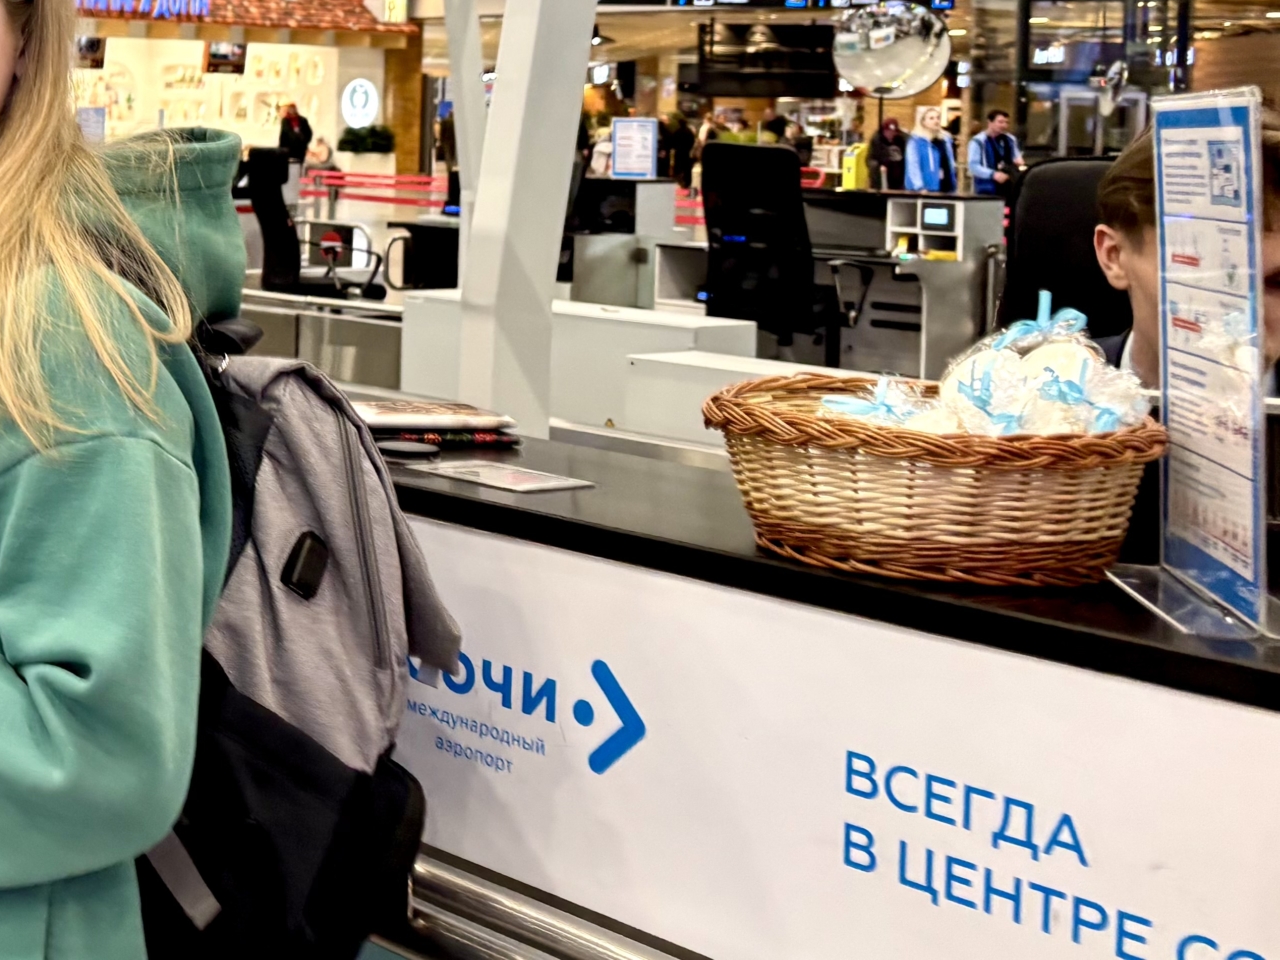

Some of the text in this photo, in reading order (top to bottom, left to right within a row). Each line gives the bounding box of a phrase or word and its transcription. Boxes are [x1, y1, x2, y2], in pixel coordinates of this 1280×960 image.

[406, 697, 547, 757] международный
[435, 734, 513, 775] аэропорт
[845, 749, 1090, 868] ВСЕГДА
[843, 821, 878, 873] В
[898, 839, 1154, 960] ЦЕНТРЕ
